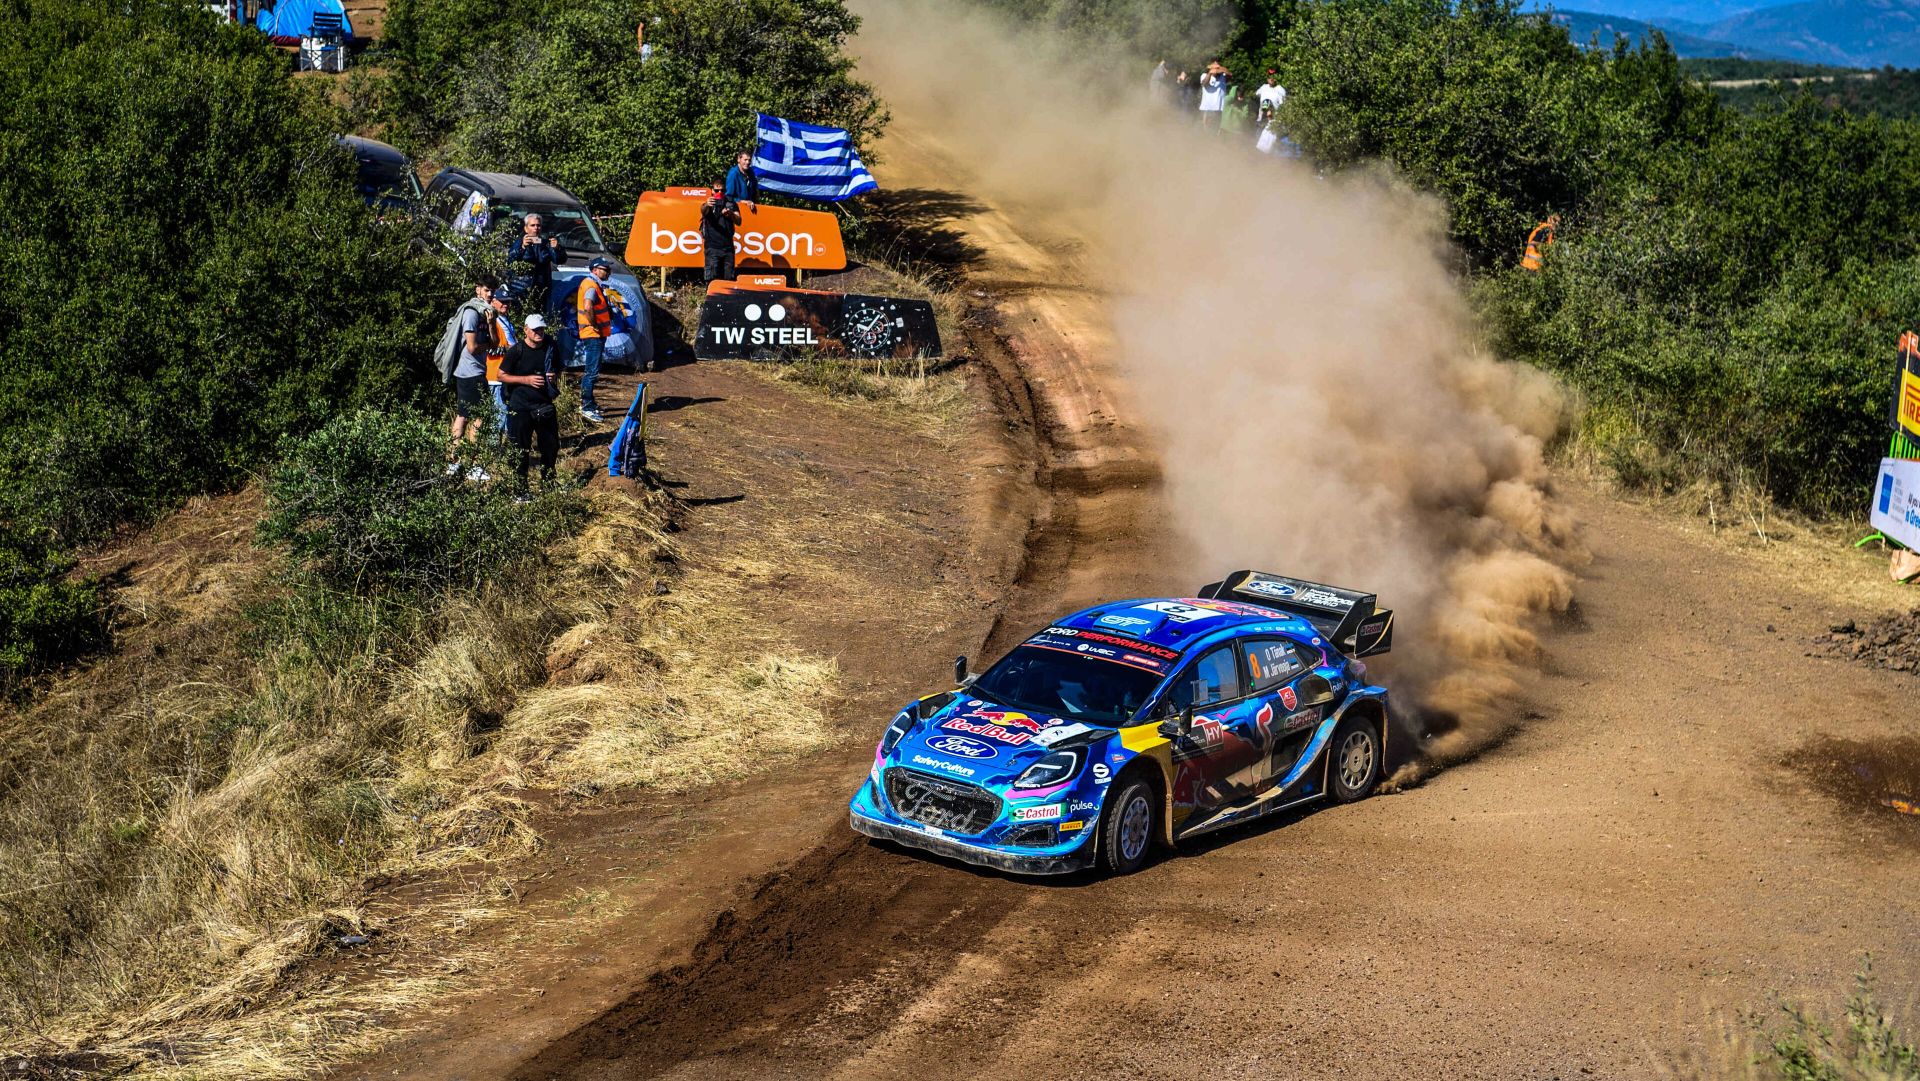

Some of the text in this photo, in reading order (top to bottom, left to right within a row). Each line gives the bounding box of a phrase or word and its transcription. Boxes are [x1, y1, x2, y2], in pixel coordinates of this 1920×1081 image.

[682, 189, 707, 197] WRC
[651, 222, 813, 256] beson
[711, 327, 818, 345] TW STEEL
[1043, 627, 1079, 636] FORD
[1075, 631, 1178, 660] PERFORMANCE
[1089, 647, 1116, 656] WRC
[1250, 653, 1261, 679] 8
[942, 717, 1033, 746] Red Bull
[1207, 725, 1220, 740] HY
[935, 737, 987, 757] Ford
[912, 755, 975, 776] SafetyCulture
[898, 783, 976, 832] Ford
[1026, 806, 1058, 819] Castrol
[1070, 801, 1093, 813] pulse
